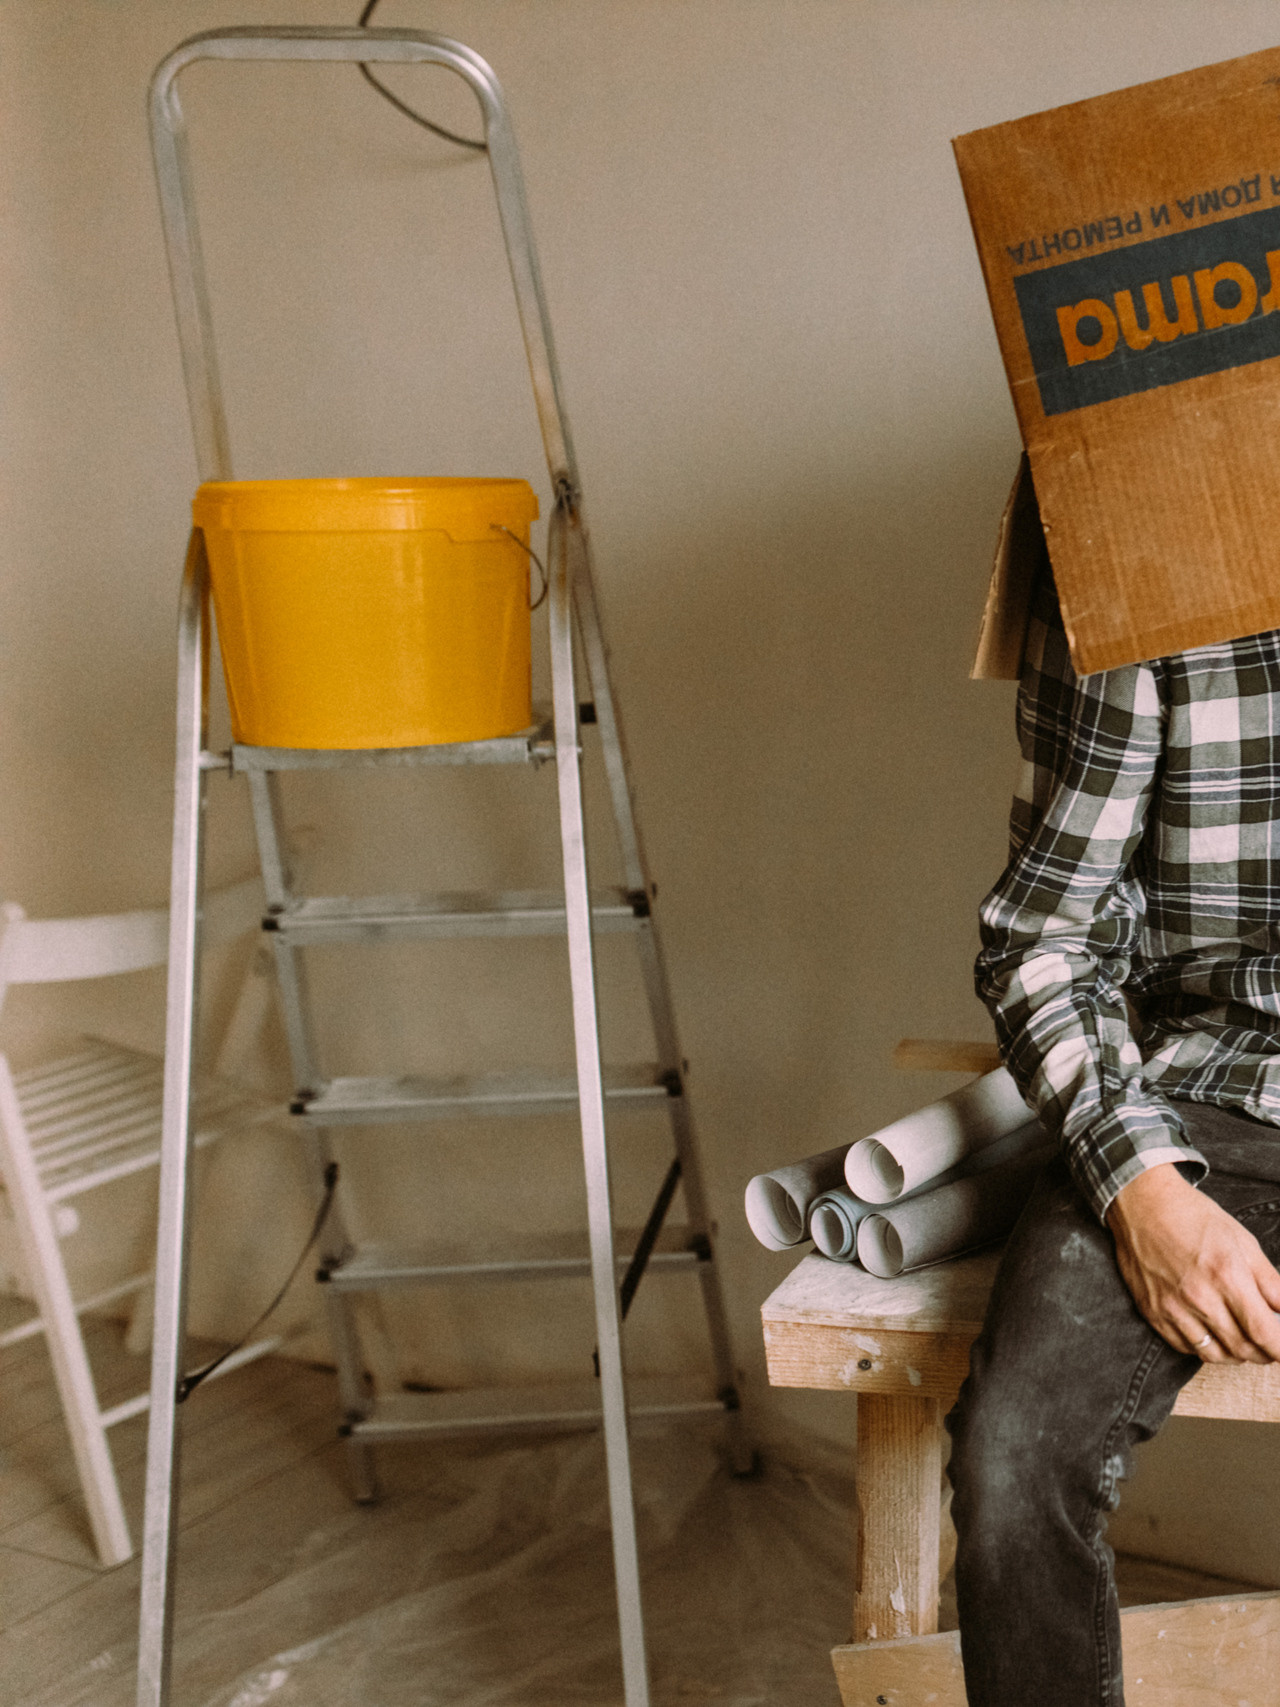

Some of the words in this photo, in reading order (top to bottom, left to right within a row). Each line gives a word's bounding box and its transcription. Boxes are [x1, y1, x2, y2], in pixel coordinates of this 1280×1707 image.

[1150, 203, 1171, 229] И
[1176, 173, 1261, 220] ДОМА
[1005, 210, 1143, 265] РЕМОНТА
